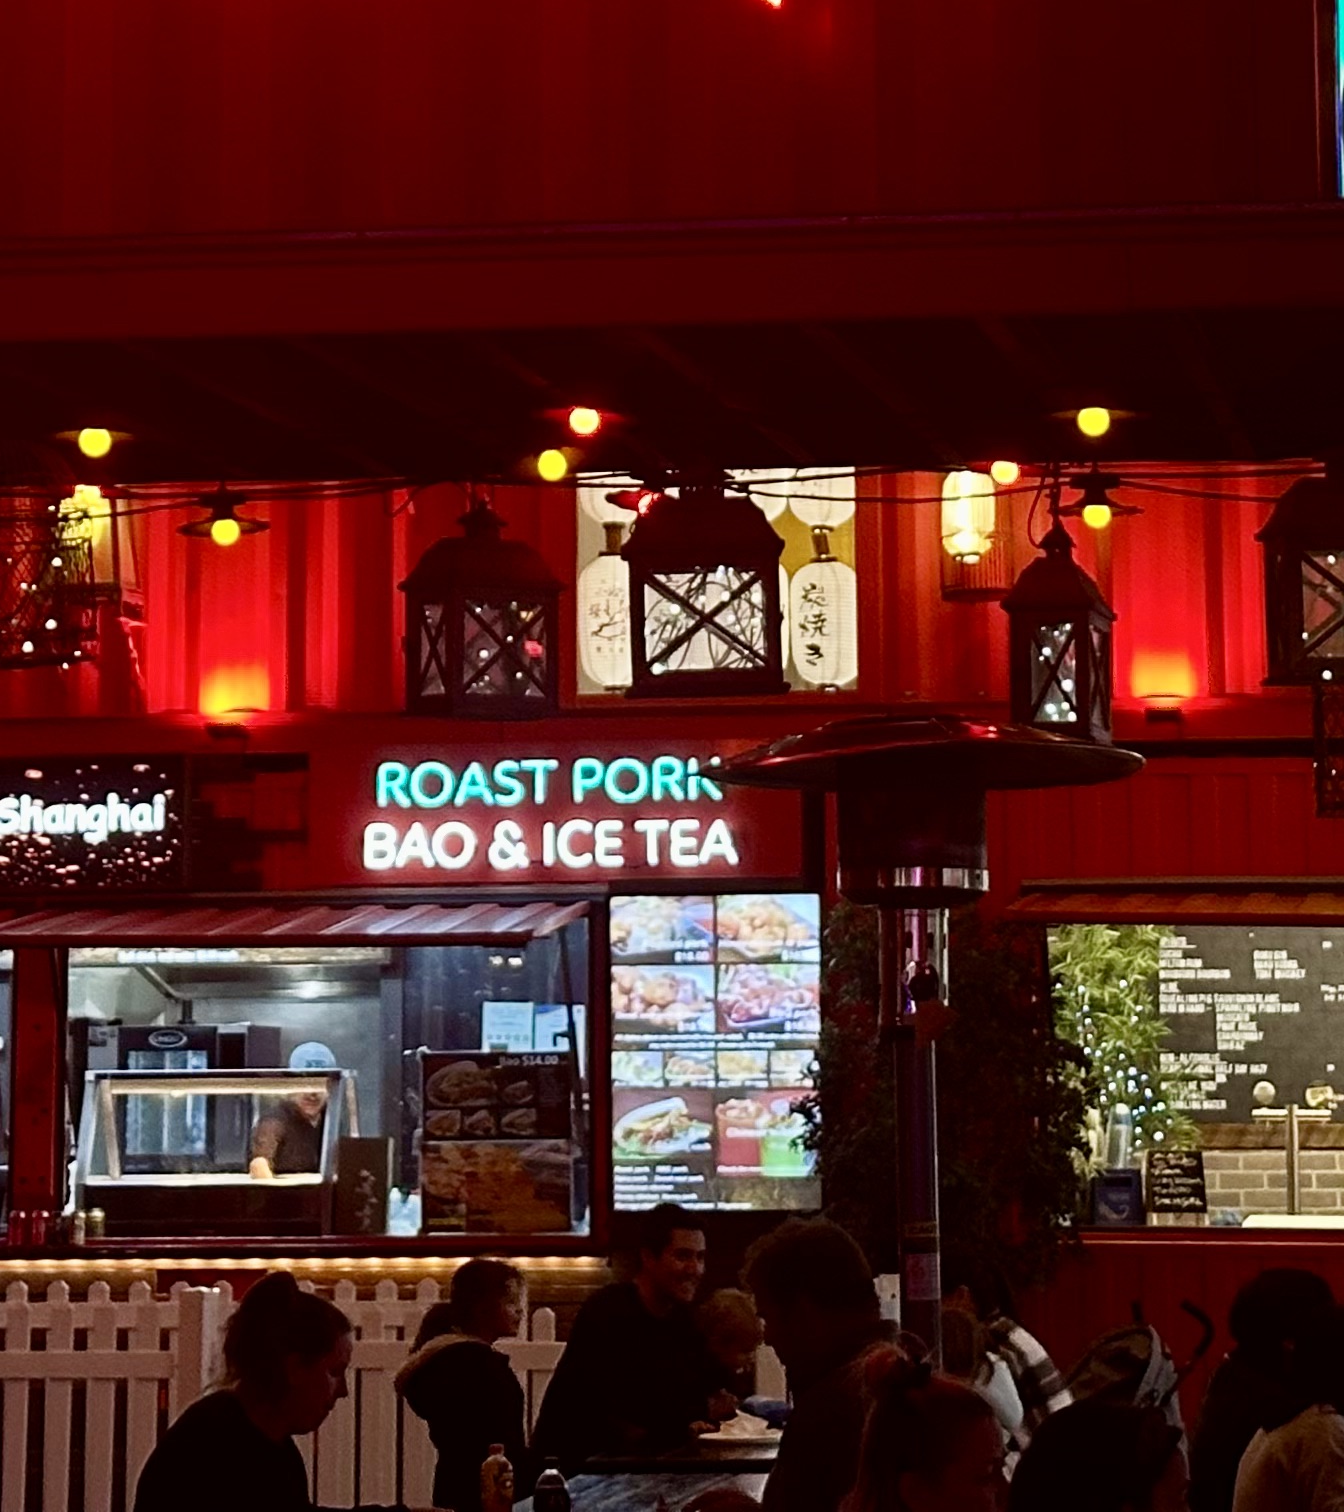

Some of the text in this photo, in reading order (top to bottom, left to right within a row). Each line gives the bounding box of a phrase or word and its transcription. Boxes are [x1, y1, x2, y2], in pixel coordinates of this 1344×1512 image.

[376, 755, 723, 809] ROAST PORK
[362, 818, 740, 871] BAO & ICE TEA
